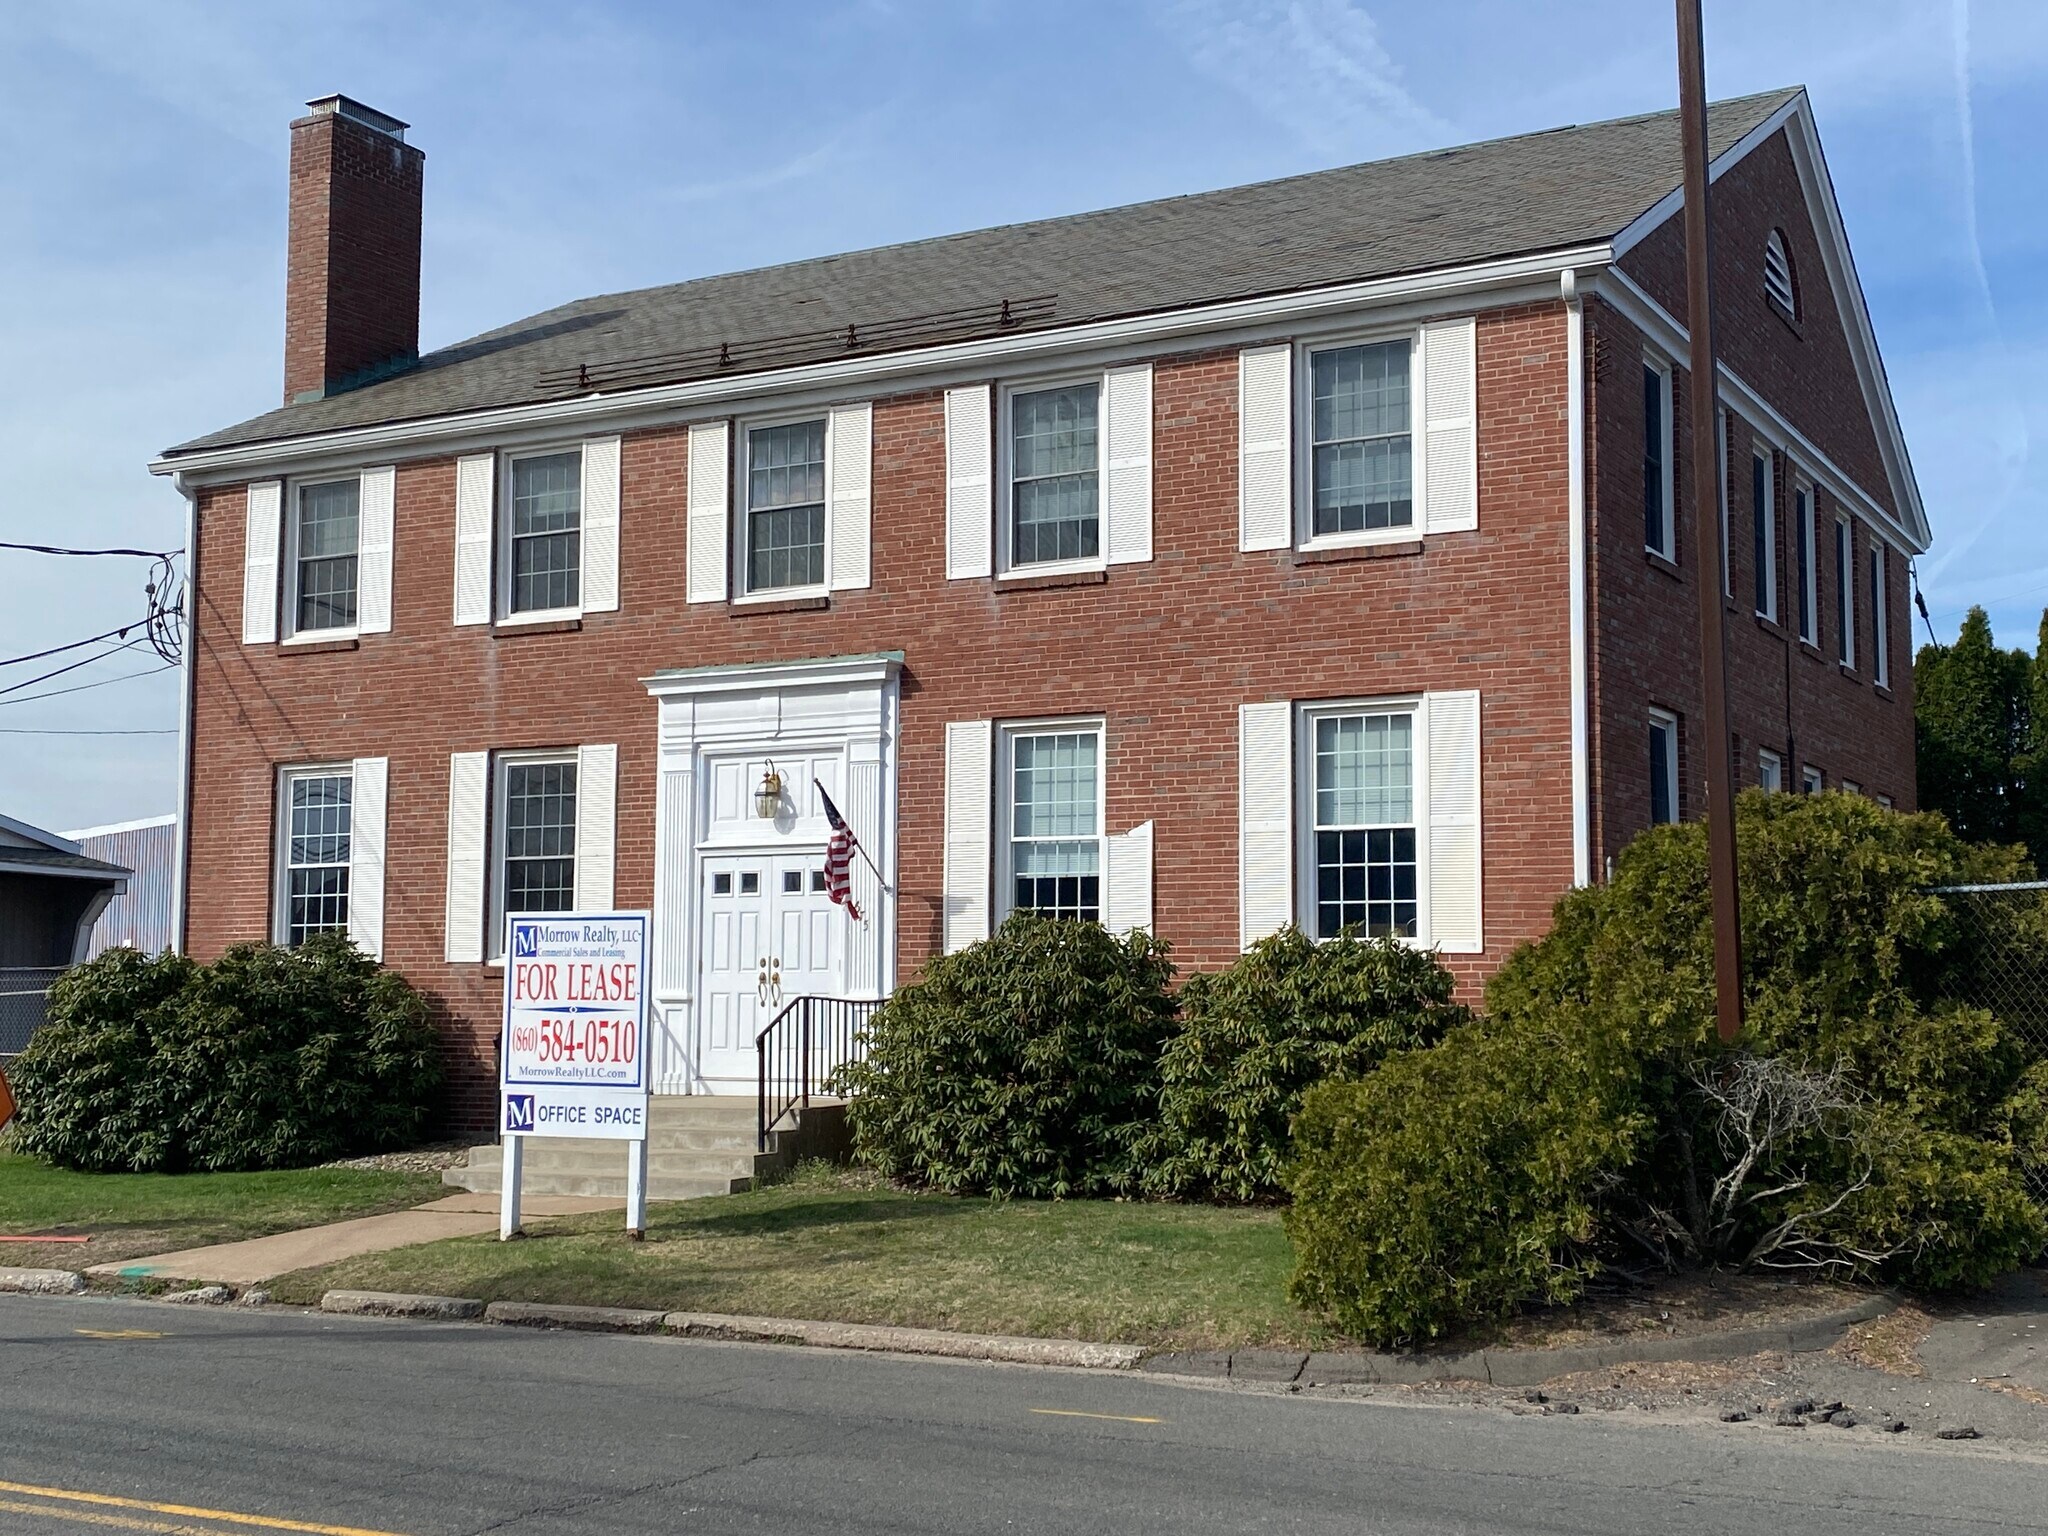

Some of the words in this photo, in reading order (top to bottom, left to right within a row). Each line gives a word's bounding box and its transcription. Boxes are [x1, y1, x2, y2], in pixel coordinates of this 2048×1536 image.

[538, 926, 580, 943] Morrow
[583, 925, 619, 948] Realty,
[622, 929, 639, 943] LLC
[537, 948, 572, 957] Commercial
[573, 948, 589, 957] Sales
[590, 948, 601, 957] and
[602, 948, 626, 960] Leasing
[515, 964, 558, 1001] FOR
[567, 964, 637, 1001] LEASE
[512, 1025, 538, 1053] (860)
[538, 1019, 636, 1064] 584-0510
[518, 1066, 627, 1080] MorrowRealtyLLC.com
[538, 1106, 586, 1123] OFFICE
[594, 1107, 641, 1125] SPACE
